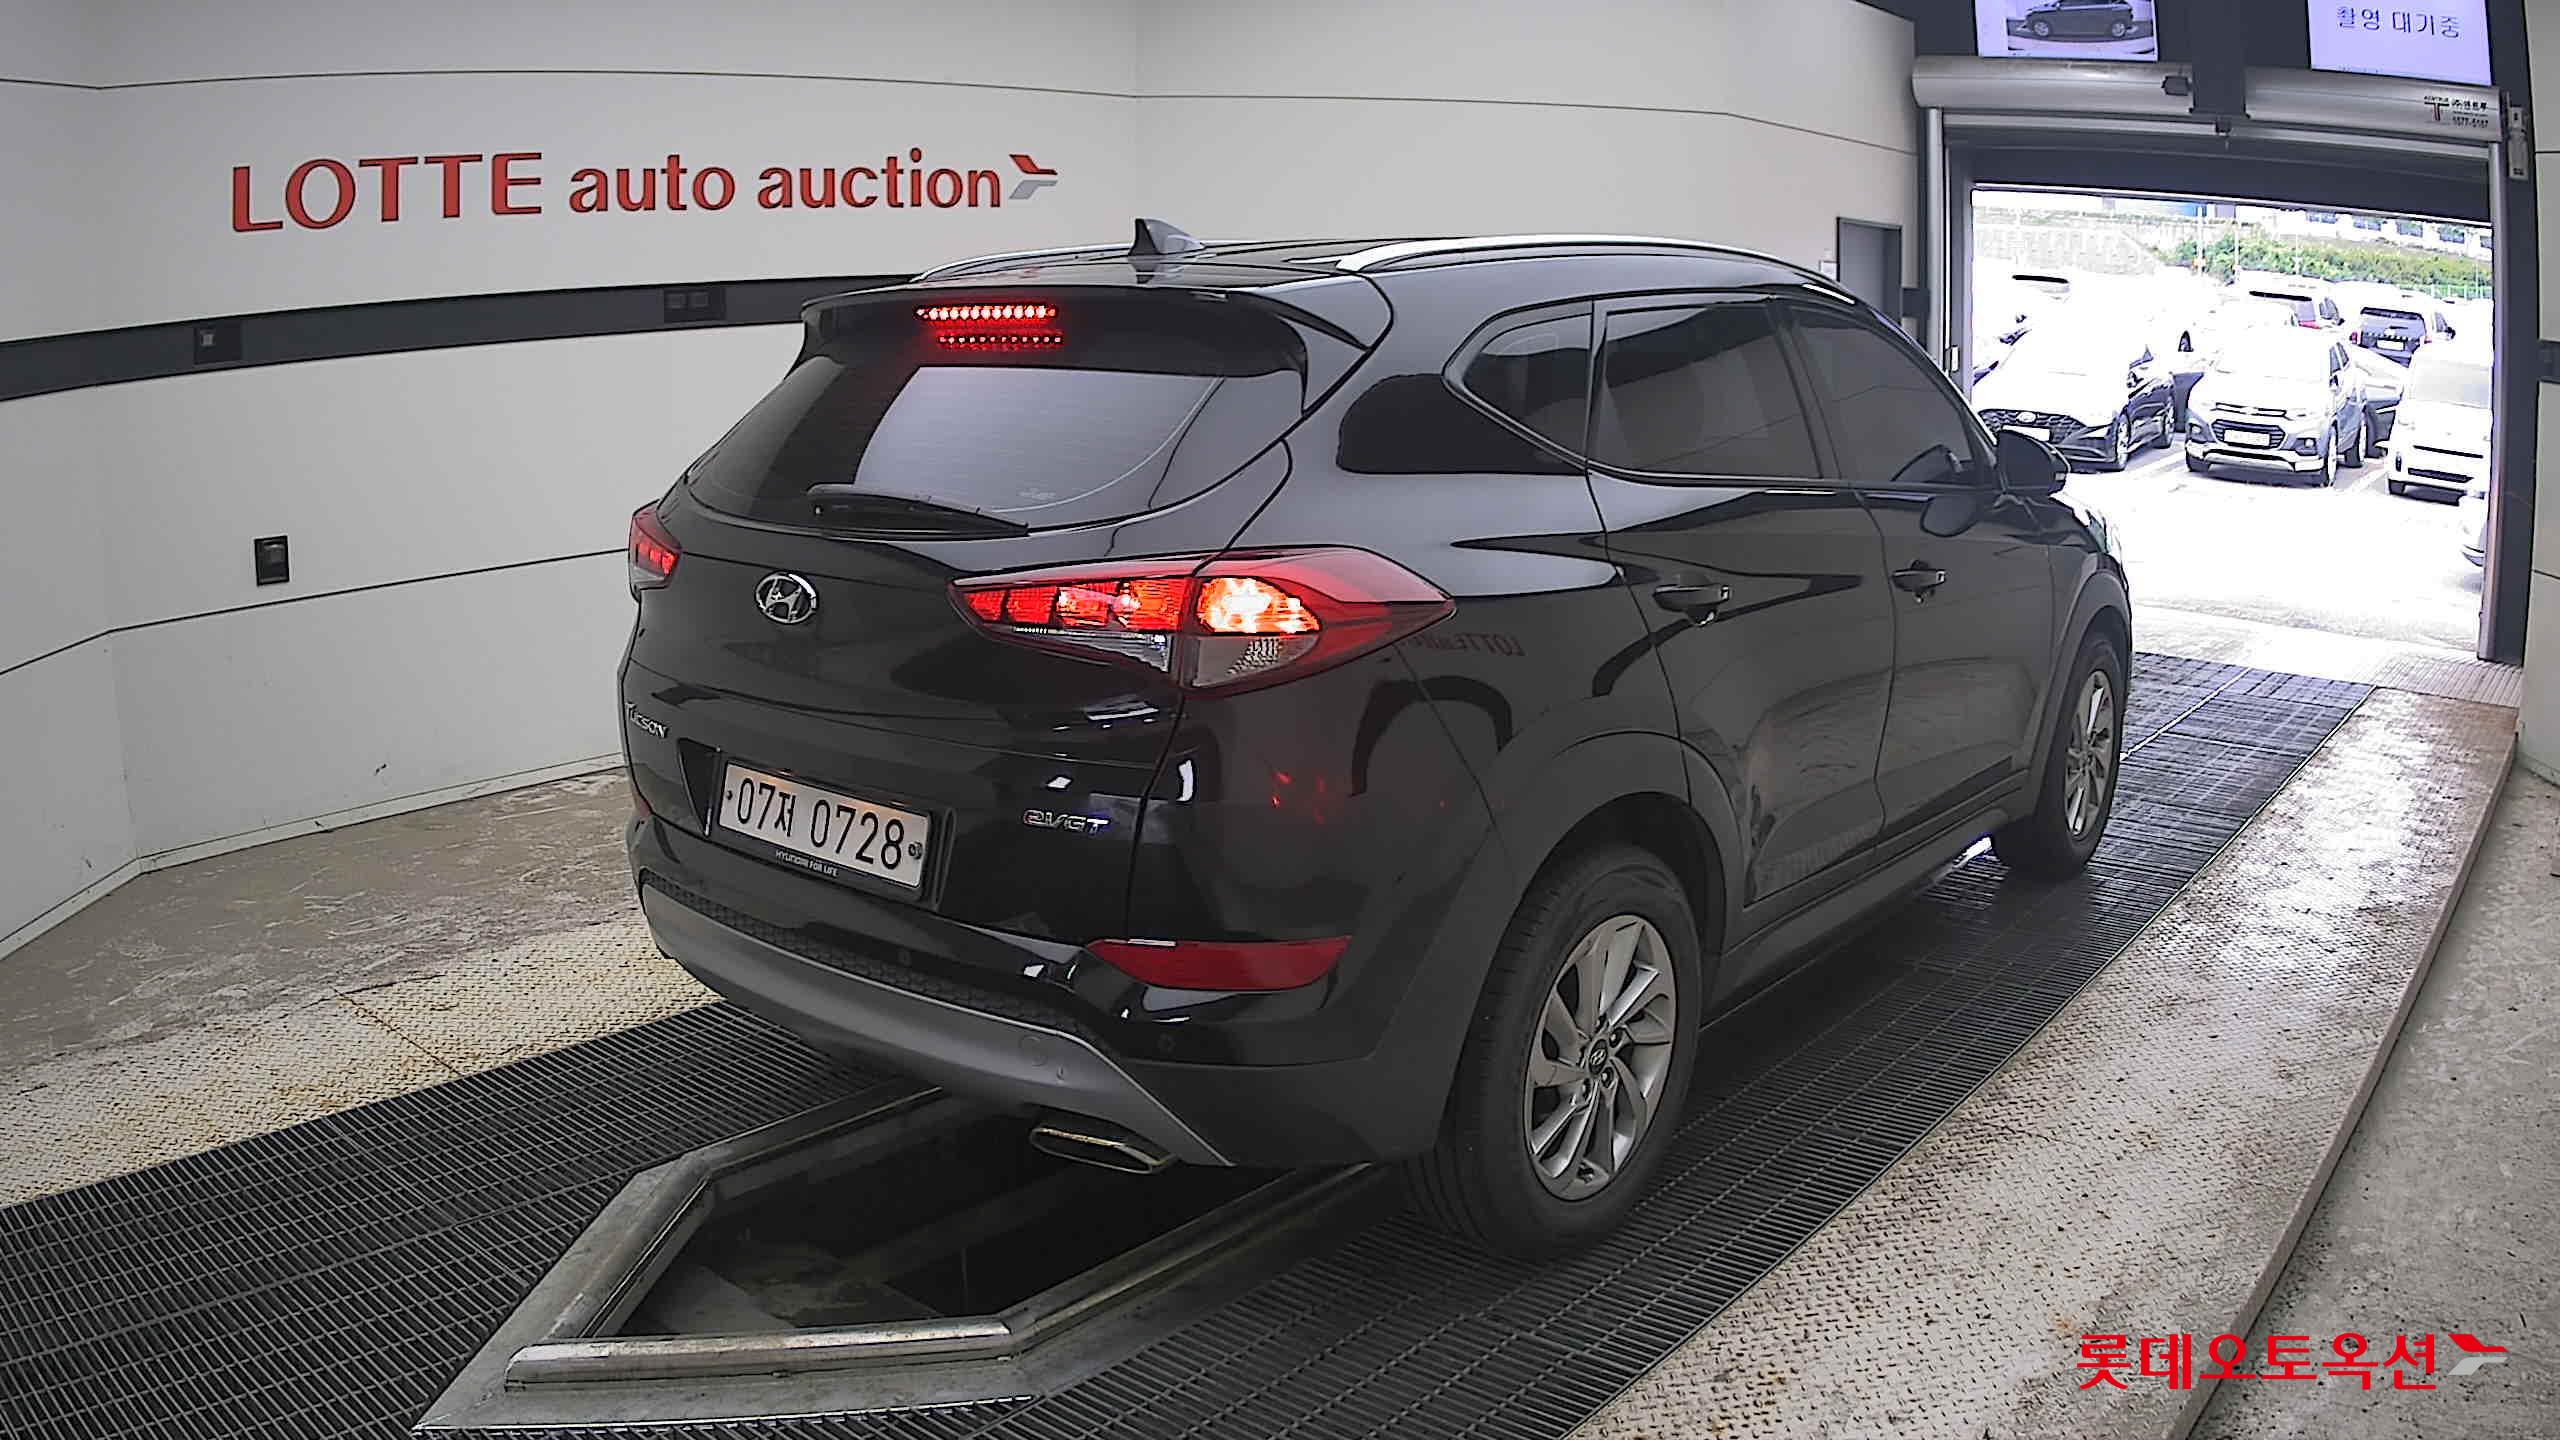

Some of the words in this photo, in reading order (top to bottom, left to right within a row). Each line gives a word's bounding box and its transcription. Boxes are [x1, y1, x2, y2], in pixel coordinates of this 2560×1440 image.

[2391, 11, 2461, 39] 대기중
[232, 151, 543, 233] LOTTE
[568, 153, 736, 214] auto
[756, 146, 1001, 209] auction
[736, 777, 796, 838] 07저
[810, 799, 905, 870] 0728
